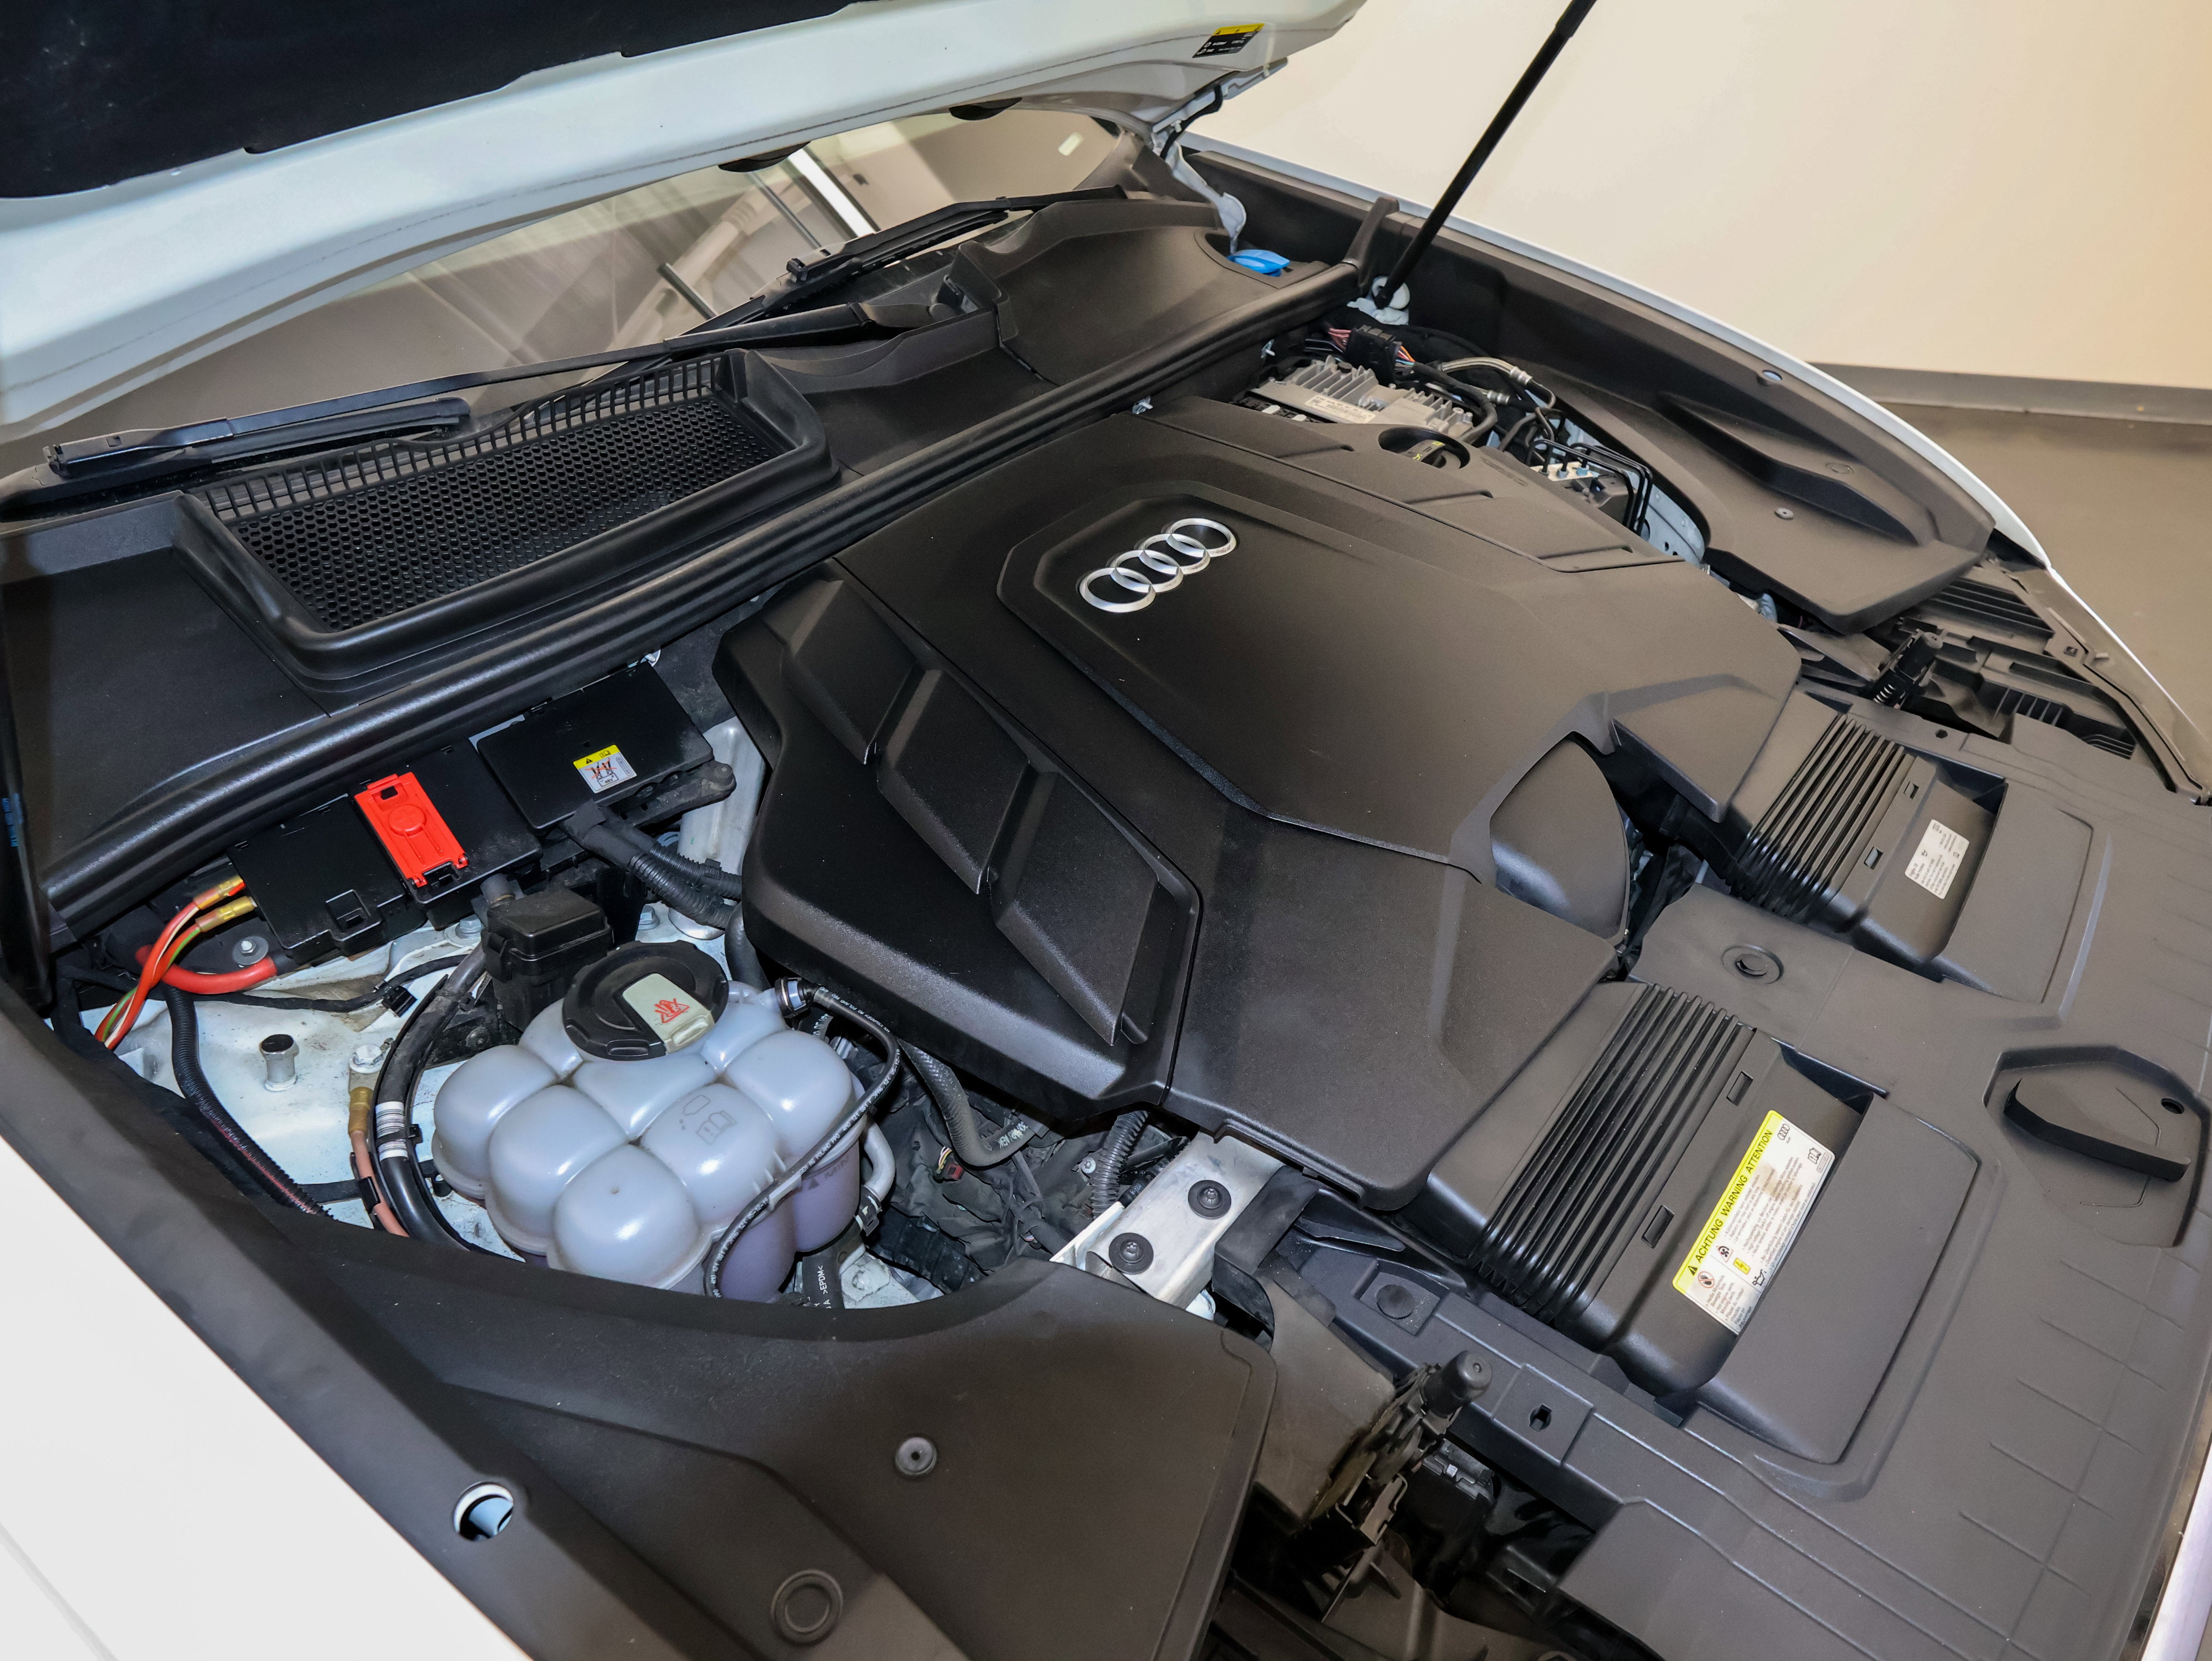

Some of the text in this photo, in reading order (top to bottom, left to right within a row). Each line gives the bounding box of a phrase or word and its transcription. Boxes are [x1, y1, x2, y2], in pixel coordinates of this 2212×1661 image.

[840, 999, 857, 1010] POLAND
[1695, 1129, 1772, 1263] ACHTUNG WARNING ATTENTION
[817, 1265, 828, 1295] >EPDM<
